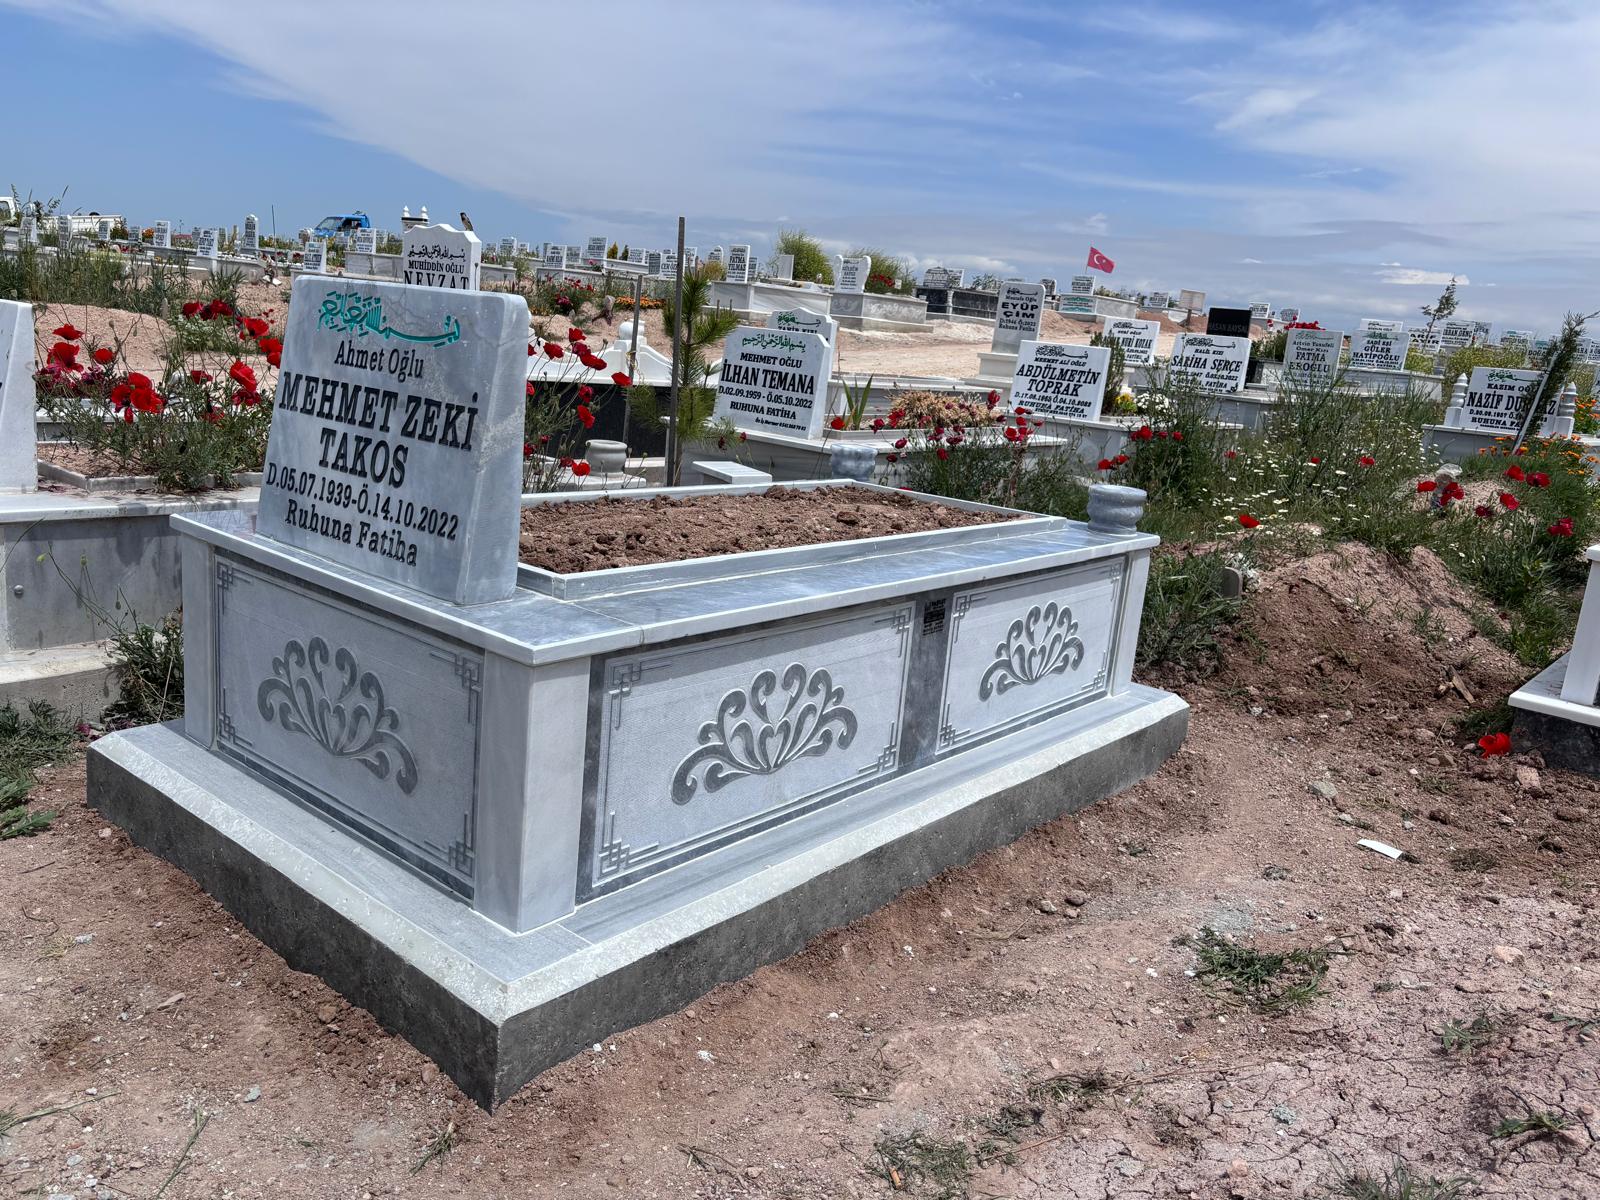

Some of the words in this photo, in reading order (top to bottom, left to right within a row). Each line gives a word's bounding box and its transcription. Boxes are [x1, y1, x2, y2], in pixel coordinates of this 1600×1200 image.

[408, 260, 445, 272] MUHİDDİN
[445, 262, 464, 275] OĞLU
[1001, 302, 1039, 311] EYÜP
[1003, 310, 1035, 319] ÇİM
[1296, 352, 1326, 362] FATMA
[1352, 351, 1400, 361] HATİPOĞLU
[1364, 345, 1391, 353] GÜLER
[334, 340, 386, 373] Ahmet
[387, 349, 425, 383] Oğlu
[740, 352, 778, 366] MEHMET
[779, 356, 803, 369] OĞLU
[720, 359, 760, 387] İLHAN
[761, 368, 815, 396] TEMANA
[1016, 363, 1101, 385] ABDÜLMETİN
[1027, 379, 1083, 397] TOPRAK
[1205, 380, 1228, 389] FATİHA
[1487, 383, 1515, 392] KAZIM
[1018, 400, 1052, 410] RUHUNA
[1054, 403, 1085, 414] FATİHA
[1466, 390, 1503, 410] NAZİF
[278, 371, 399, 434] MEHMET
[401, 392, 479, 452] ZEKİ
[730, 401, 765, 415] RUHUNA
[766, 406, 797, 420] FATİHA
[1471, 417, 1507, 426] RUHUNA
[318, 427, 409, 488] TAKOS
[285, 498, 352, 545] Ruhuna
[355, 520, 418, 567] Fatiha
